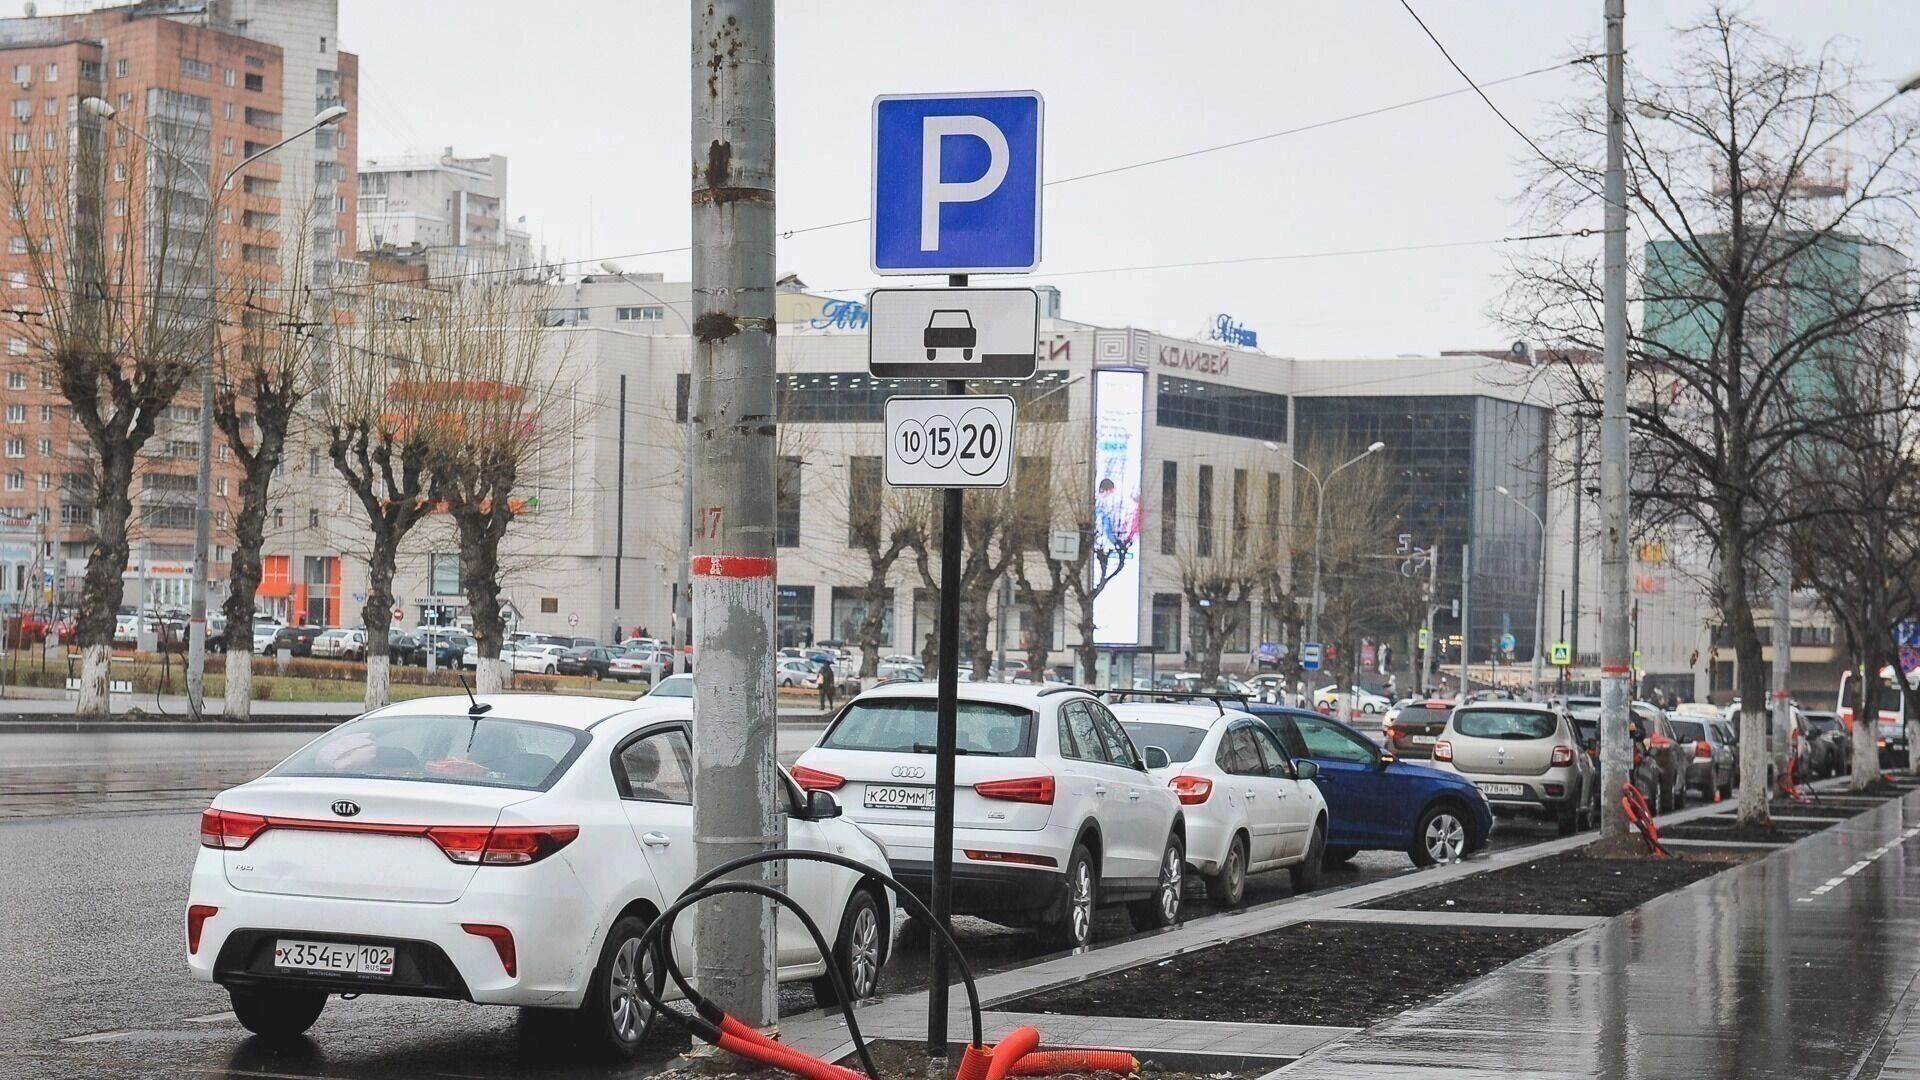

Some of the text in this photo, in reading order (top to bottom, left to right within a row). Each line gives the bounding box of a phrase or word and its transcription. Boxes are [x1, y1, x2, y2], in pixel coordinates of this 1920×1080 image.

[920, 115, 1010, 252] P
[1159, 344, 1229, 377] КОЛИЗЕЙ
[902, 423, 997, 459] 10 15 20
[334, 803, 355, 814] KIA
[869, 788, 925, 804] К209ММ
[280, 944, 390, 969] Х354ЕУ 102
[365, 964, 380, 972] RUS
